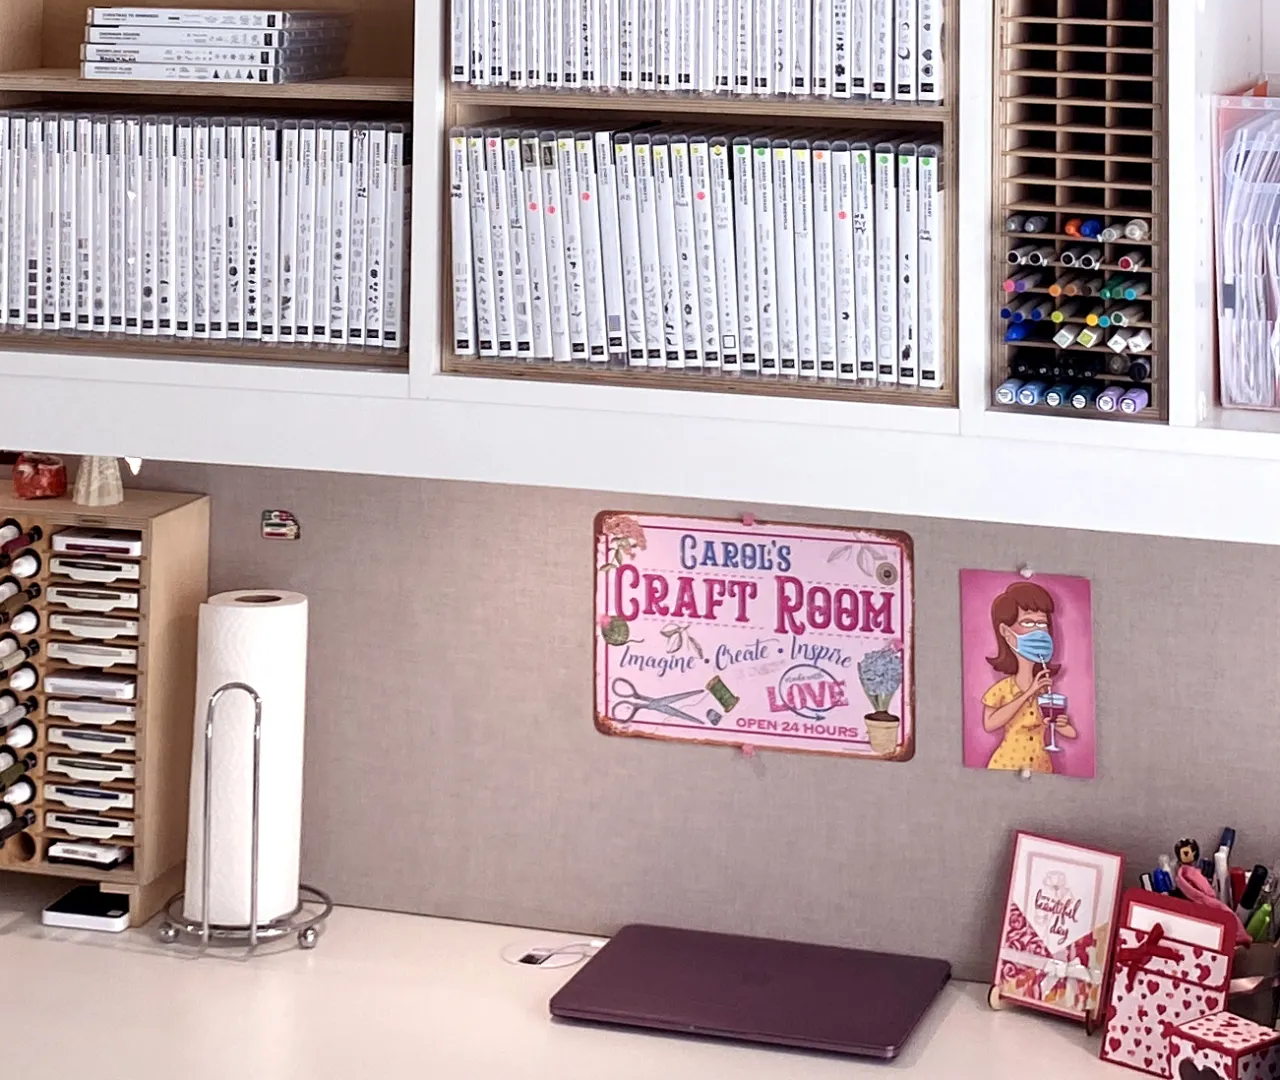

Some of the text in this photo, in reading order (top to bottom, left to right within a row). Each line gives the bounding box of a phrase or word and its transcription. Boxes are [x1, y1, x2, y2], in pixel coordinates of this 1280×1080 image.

[681, 534, 791, 572] CAROL'S
[614, 563, 895, 635] CRAFT ROOM
[620, 635, 852, 677] Imagine Create Inspire
[767, 680, 848, 712] LOVE
[736, 718, 858, 738] OPEN 24 HOURS
[1035, 888, 1081, 925] beautiful
[1050, 915, 1069, 945] day
